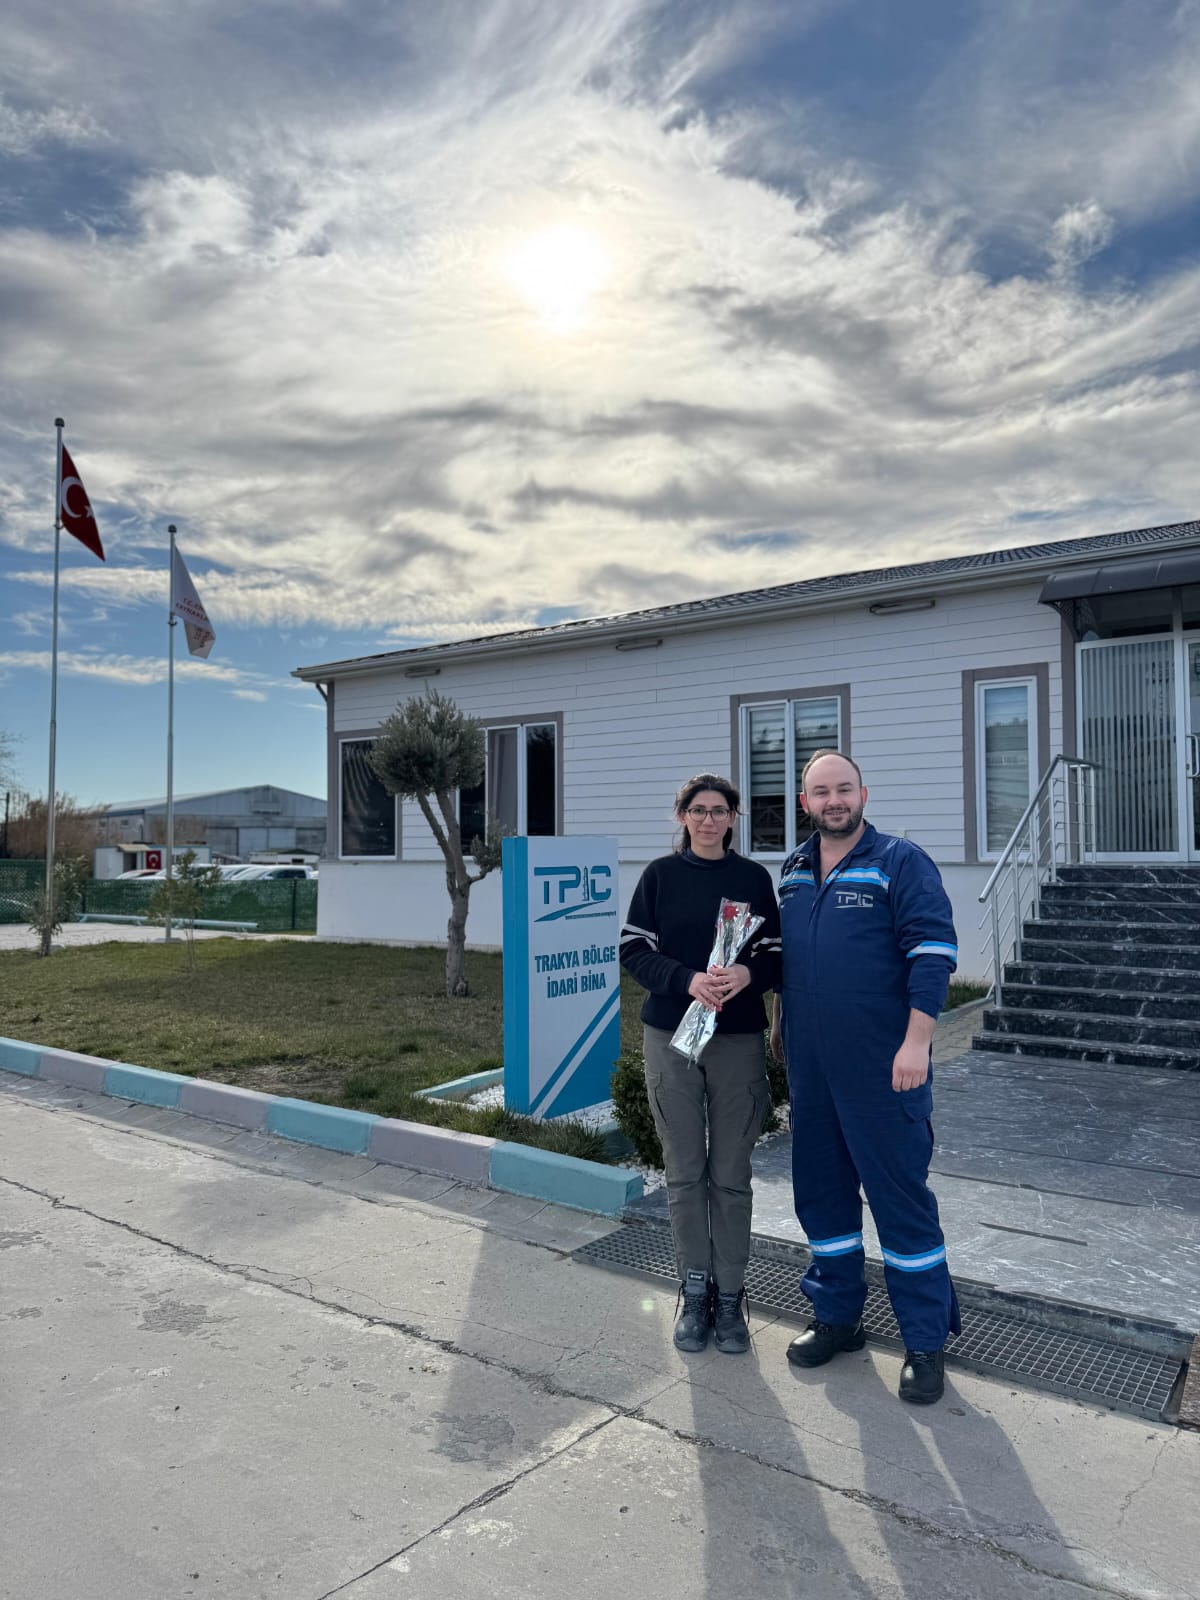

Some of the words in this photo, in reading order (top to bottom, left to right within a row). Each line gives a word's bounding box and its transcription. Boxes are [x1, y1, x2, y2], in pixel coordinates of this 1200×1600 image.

[534, 950, 580, 973] TRAKYA
[583, 944, 616, 966] BÖLGE
[547, 972, 578, 998] İDARİ
[581, 970, 606, 993] BİNA
